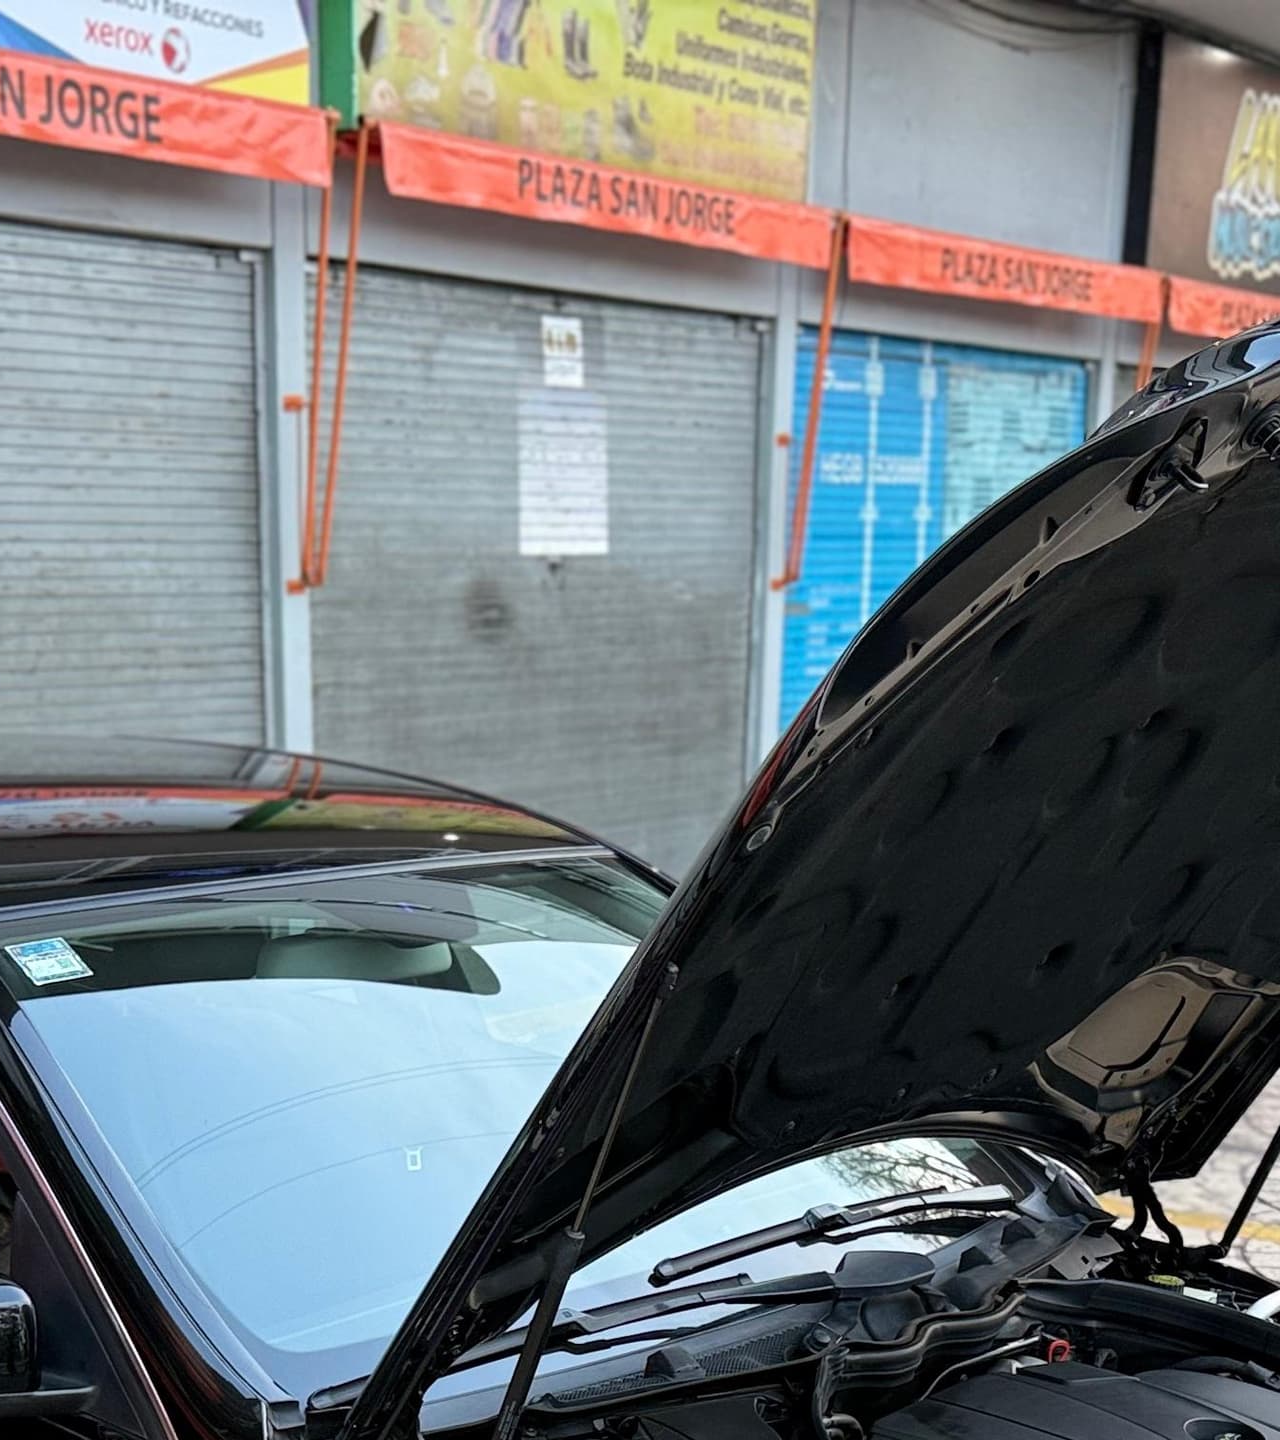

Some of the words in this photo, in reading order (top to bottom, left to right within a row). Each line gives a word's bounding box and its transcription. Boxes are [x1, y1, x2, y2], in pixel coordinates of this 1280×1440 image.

[84, 18, 154, 56] xerox
[38, 74, 164, 145] JORGE
[518, 158, 602, 211] PLAZA
[609, 176, 660, 223] SAN
[664, 189, 737, 236] JORGE
[940, 248, 997, 293] PLAZA
[1003, 254, 1040, 297] SAN
[1040, 263, 1094, 301] JORGE
